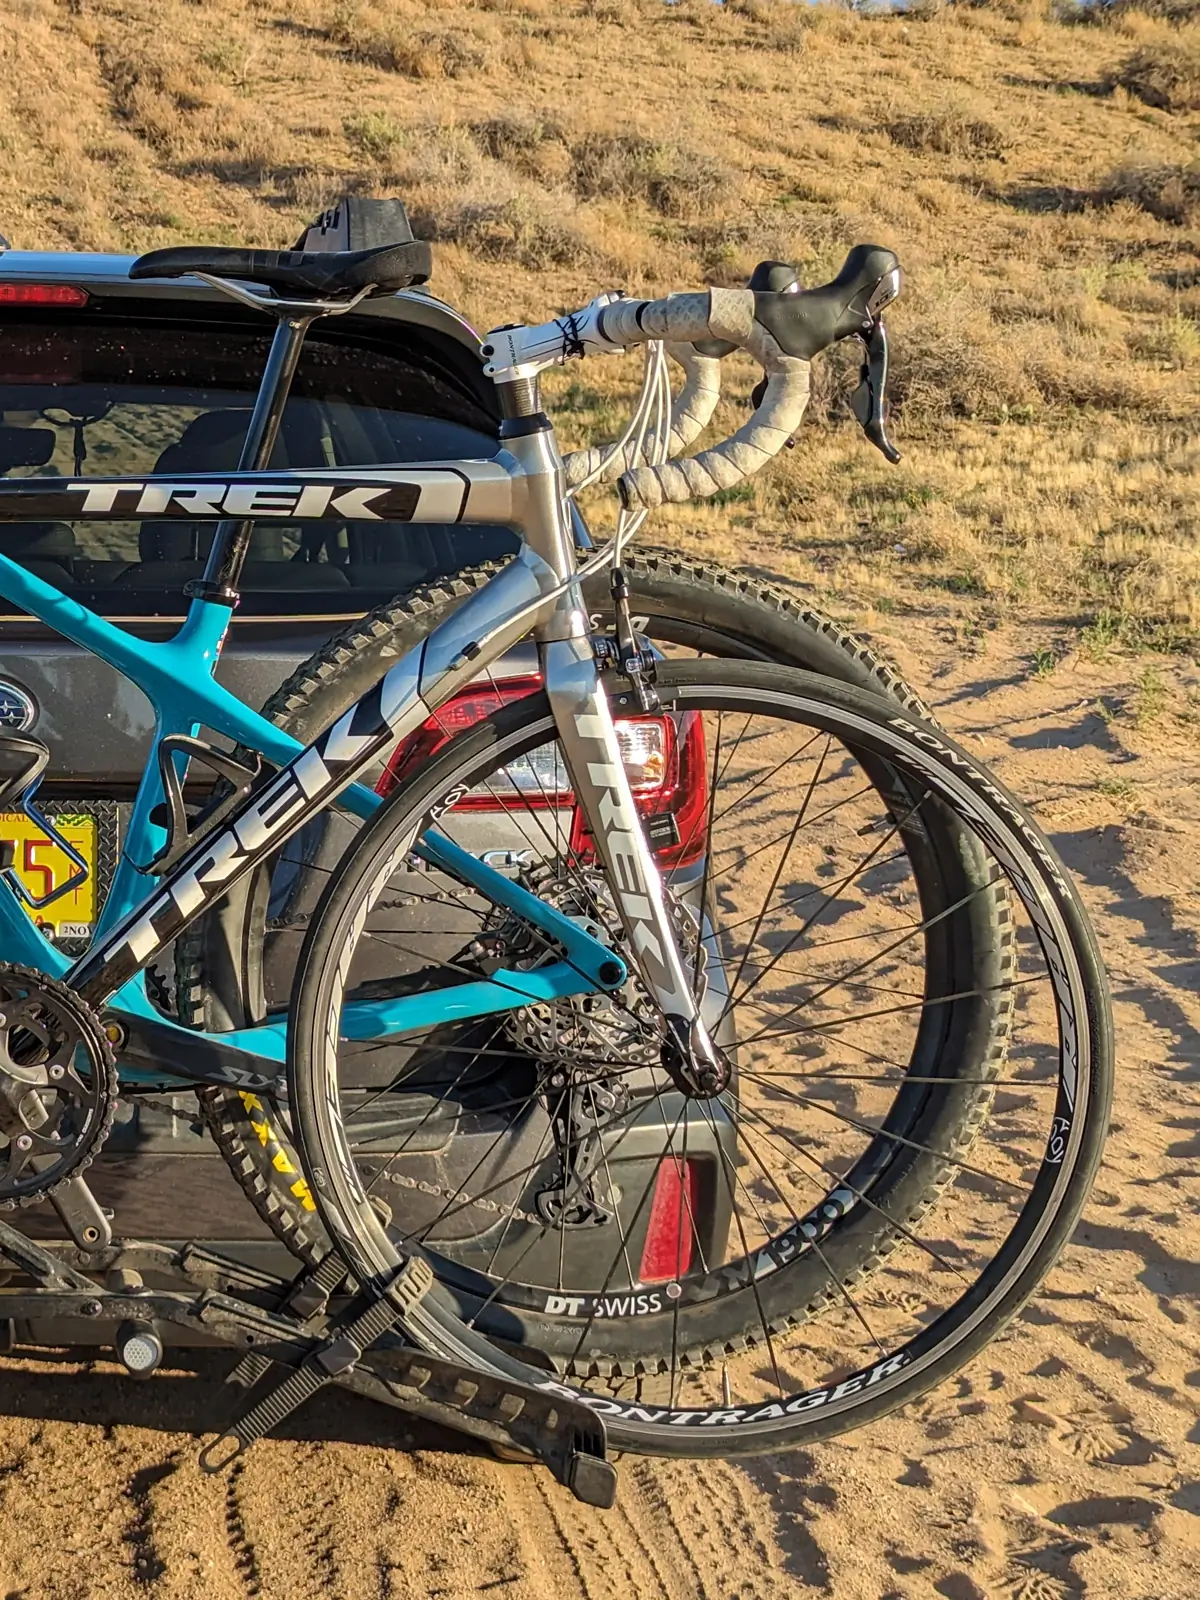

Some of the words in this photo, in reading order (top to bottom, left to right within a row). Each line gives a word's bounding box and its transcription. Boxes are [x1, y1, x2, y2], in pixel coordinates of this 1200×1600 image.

[66, 483, 393, 521] TREK
[103, 702, 378, 964] TREK
[573, 712, 666, 968] TREK
[886, 717, 1075, 901] BONTRAGER
[237, 1089, 318, 1214] MAXX
[544, 1295, 584, 1316] DT
[592, 1292, 662, 1317] SWISS
[533, 1353, 907, 1426] BONTRAGER
